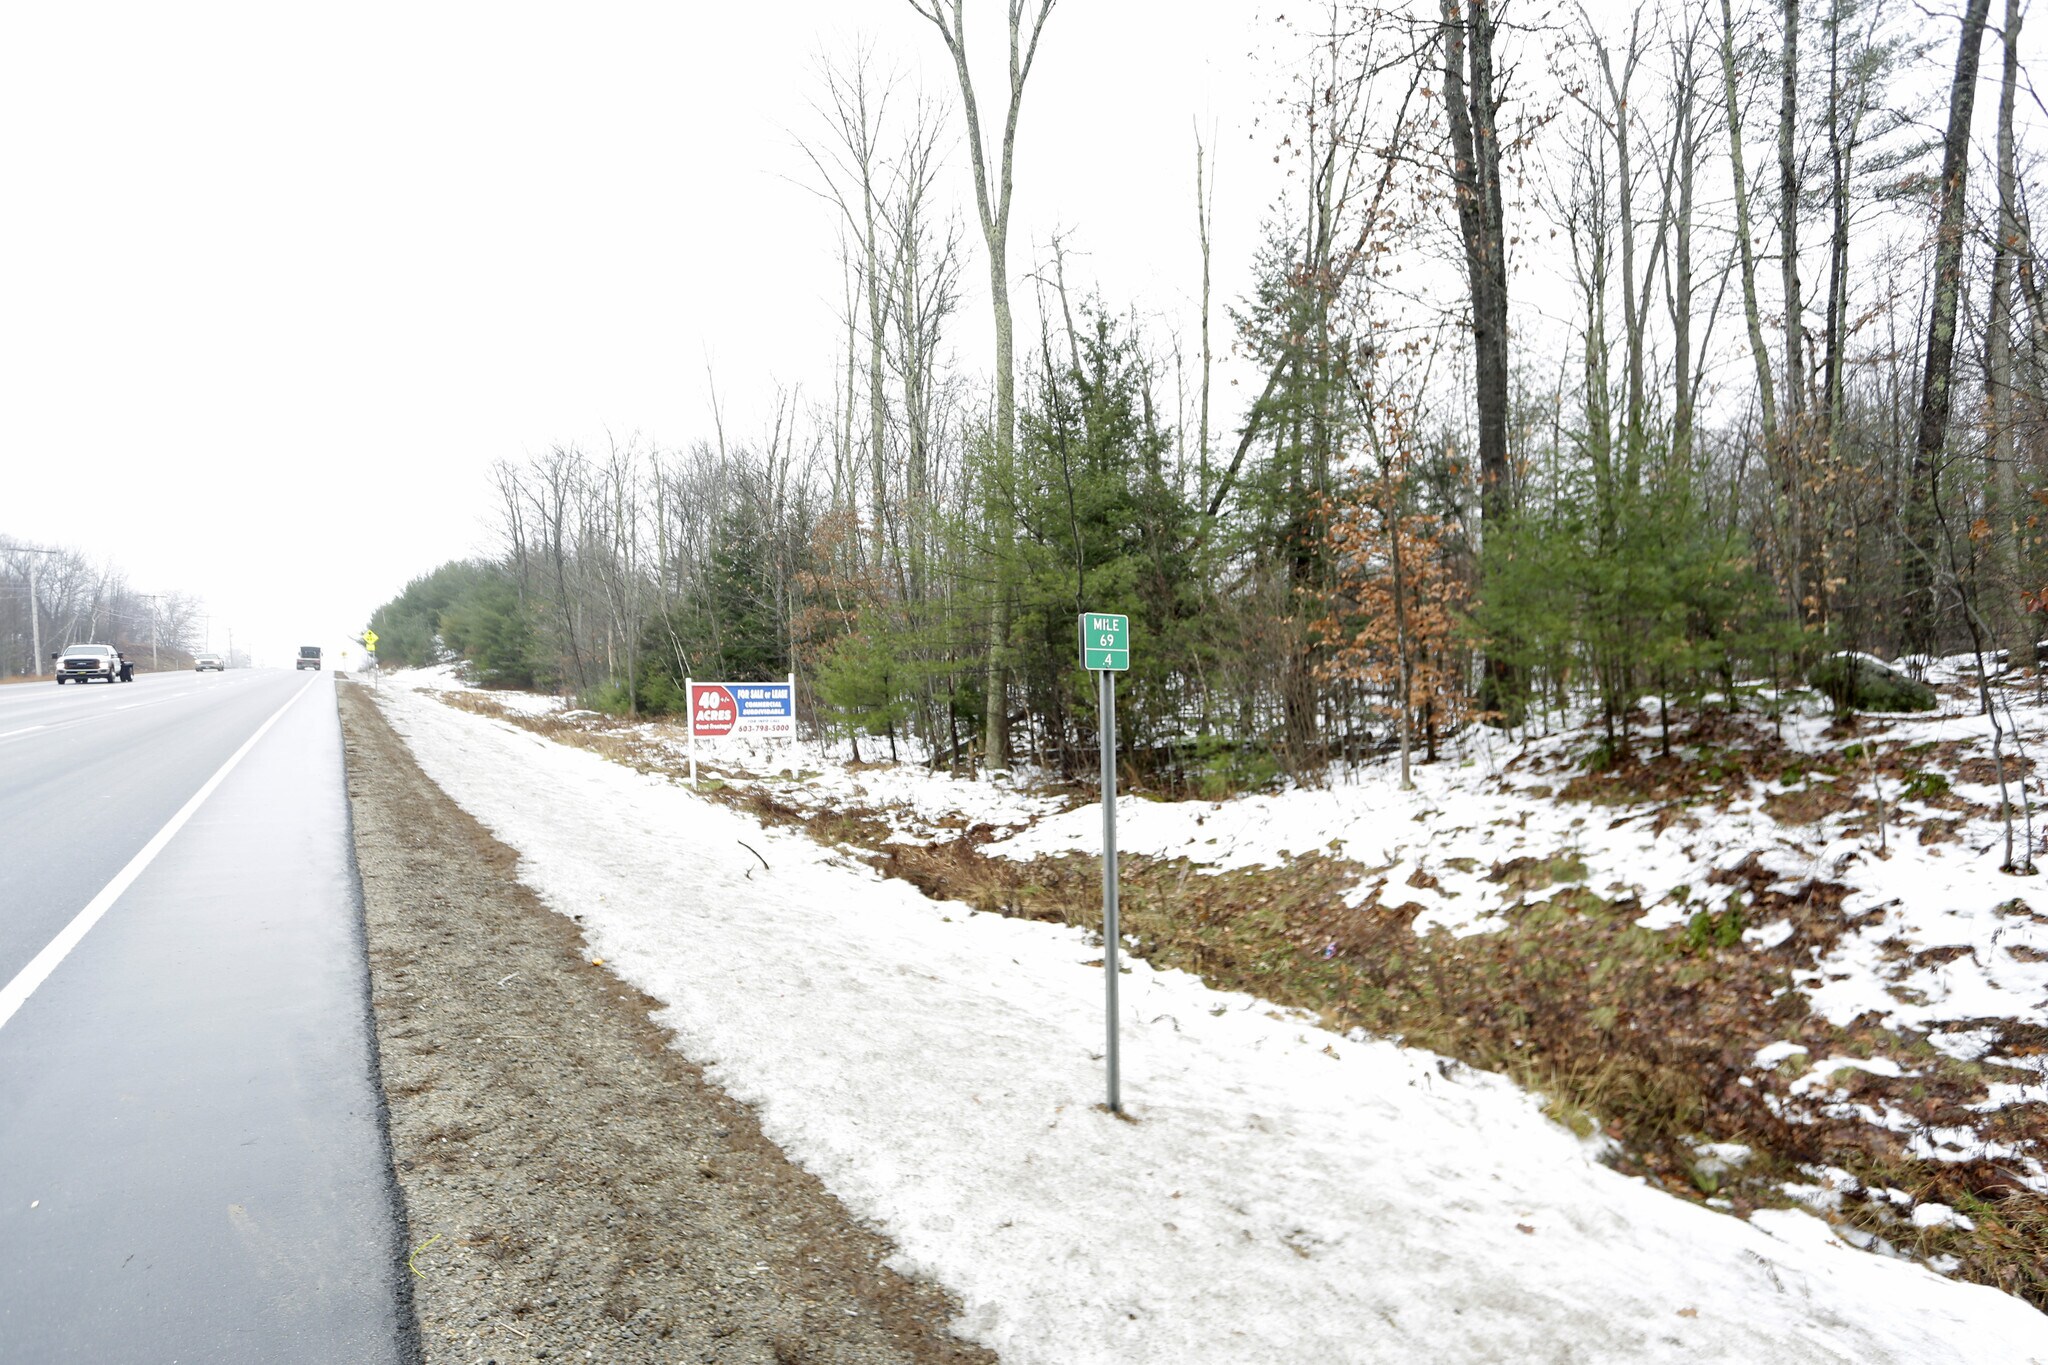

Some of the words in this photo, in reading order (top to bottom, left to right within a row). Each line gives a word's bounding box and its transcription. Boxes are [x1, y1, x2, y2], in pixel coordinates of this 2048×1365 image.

[1093, 618, 1119, 631] MILE
[1100, 634, 1114, 647] 69
[738, 689, 749, 699] FOR
[750, 689, 764, 699] SALE
[699, 692, 720, 709] 40
[696, 710, 731, 721] ACRES
[738, 724, 790, 732] 603-798-5000
